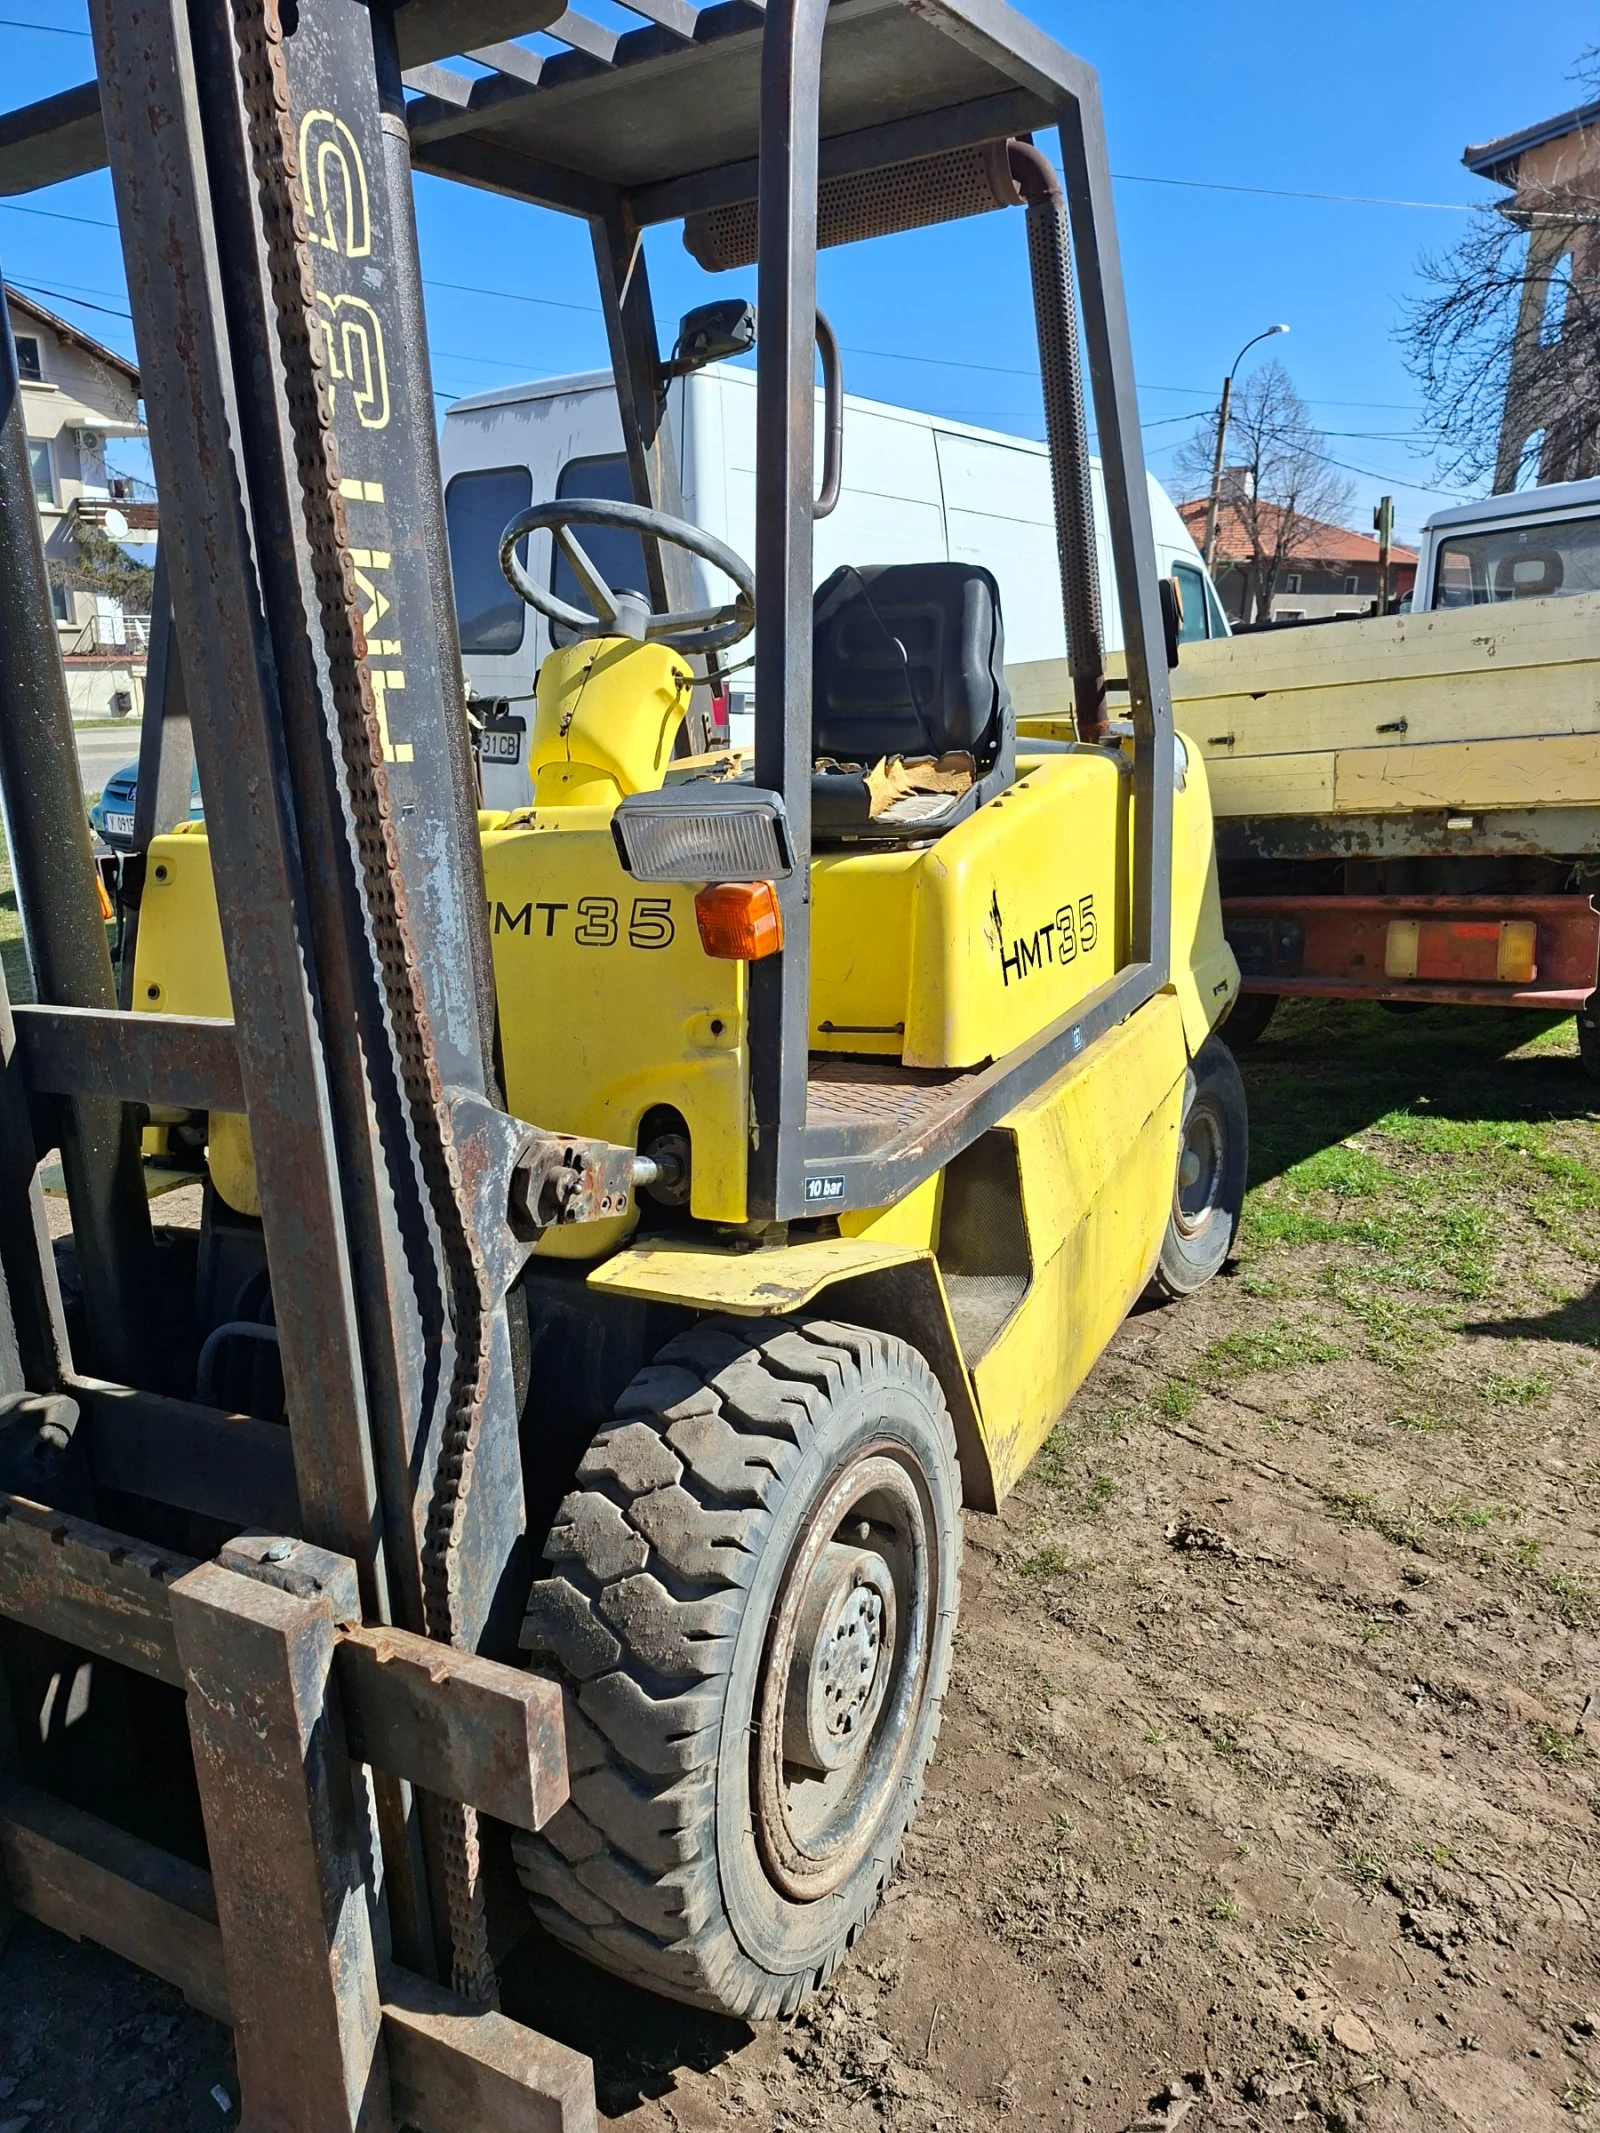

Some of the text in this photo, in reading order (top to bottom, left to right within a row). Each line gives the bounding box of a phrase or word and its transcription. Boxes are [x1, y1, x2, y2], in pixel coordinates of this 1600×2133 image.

[487, 897, 675, 949] MT35
[808, 1179, 843, 1197] 10 bar
